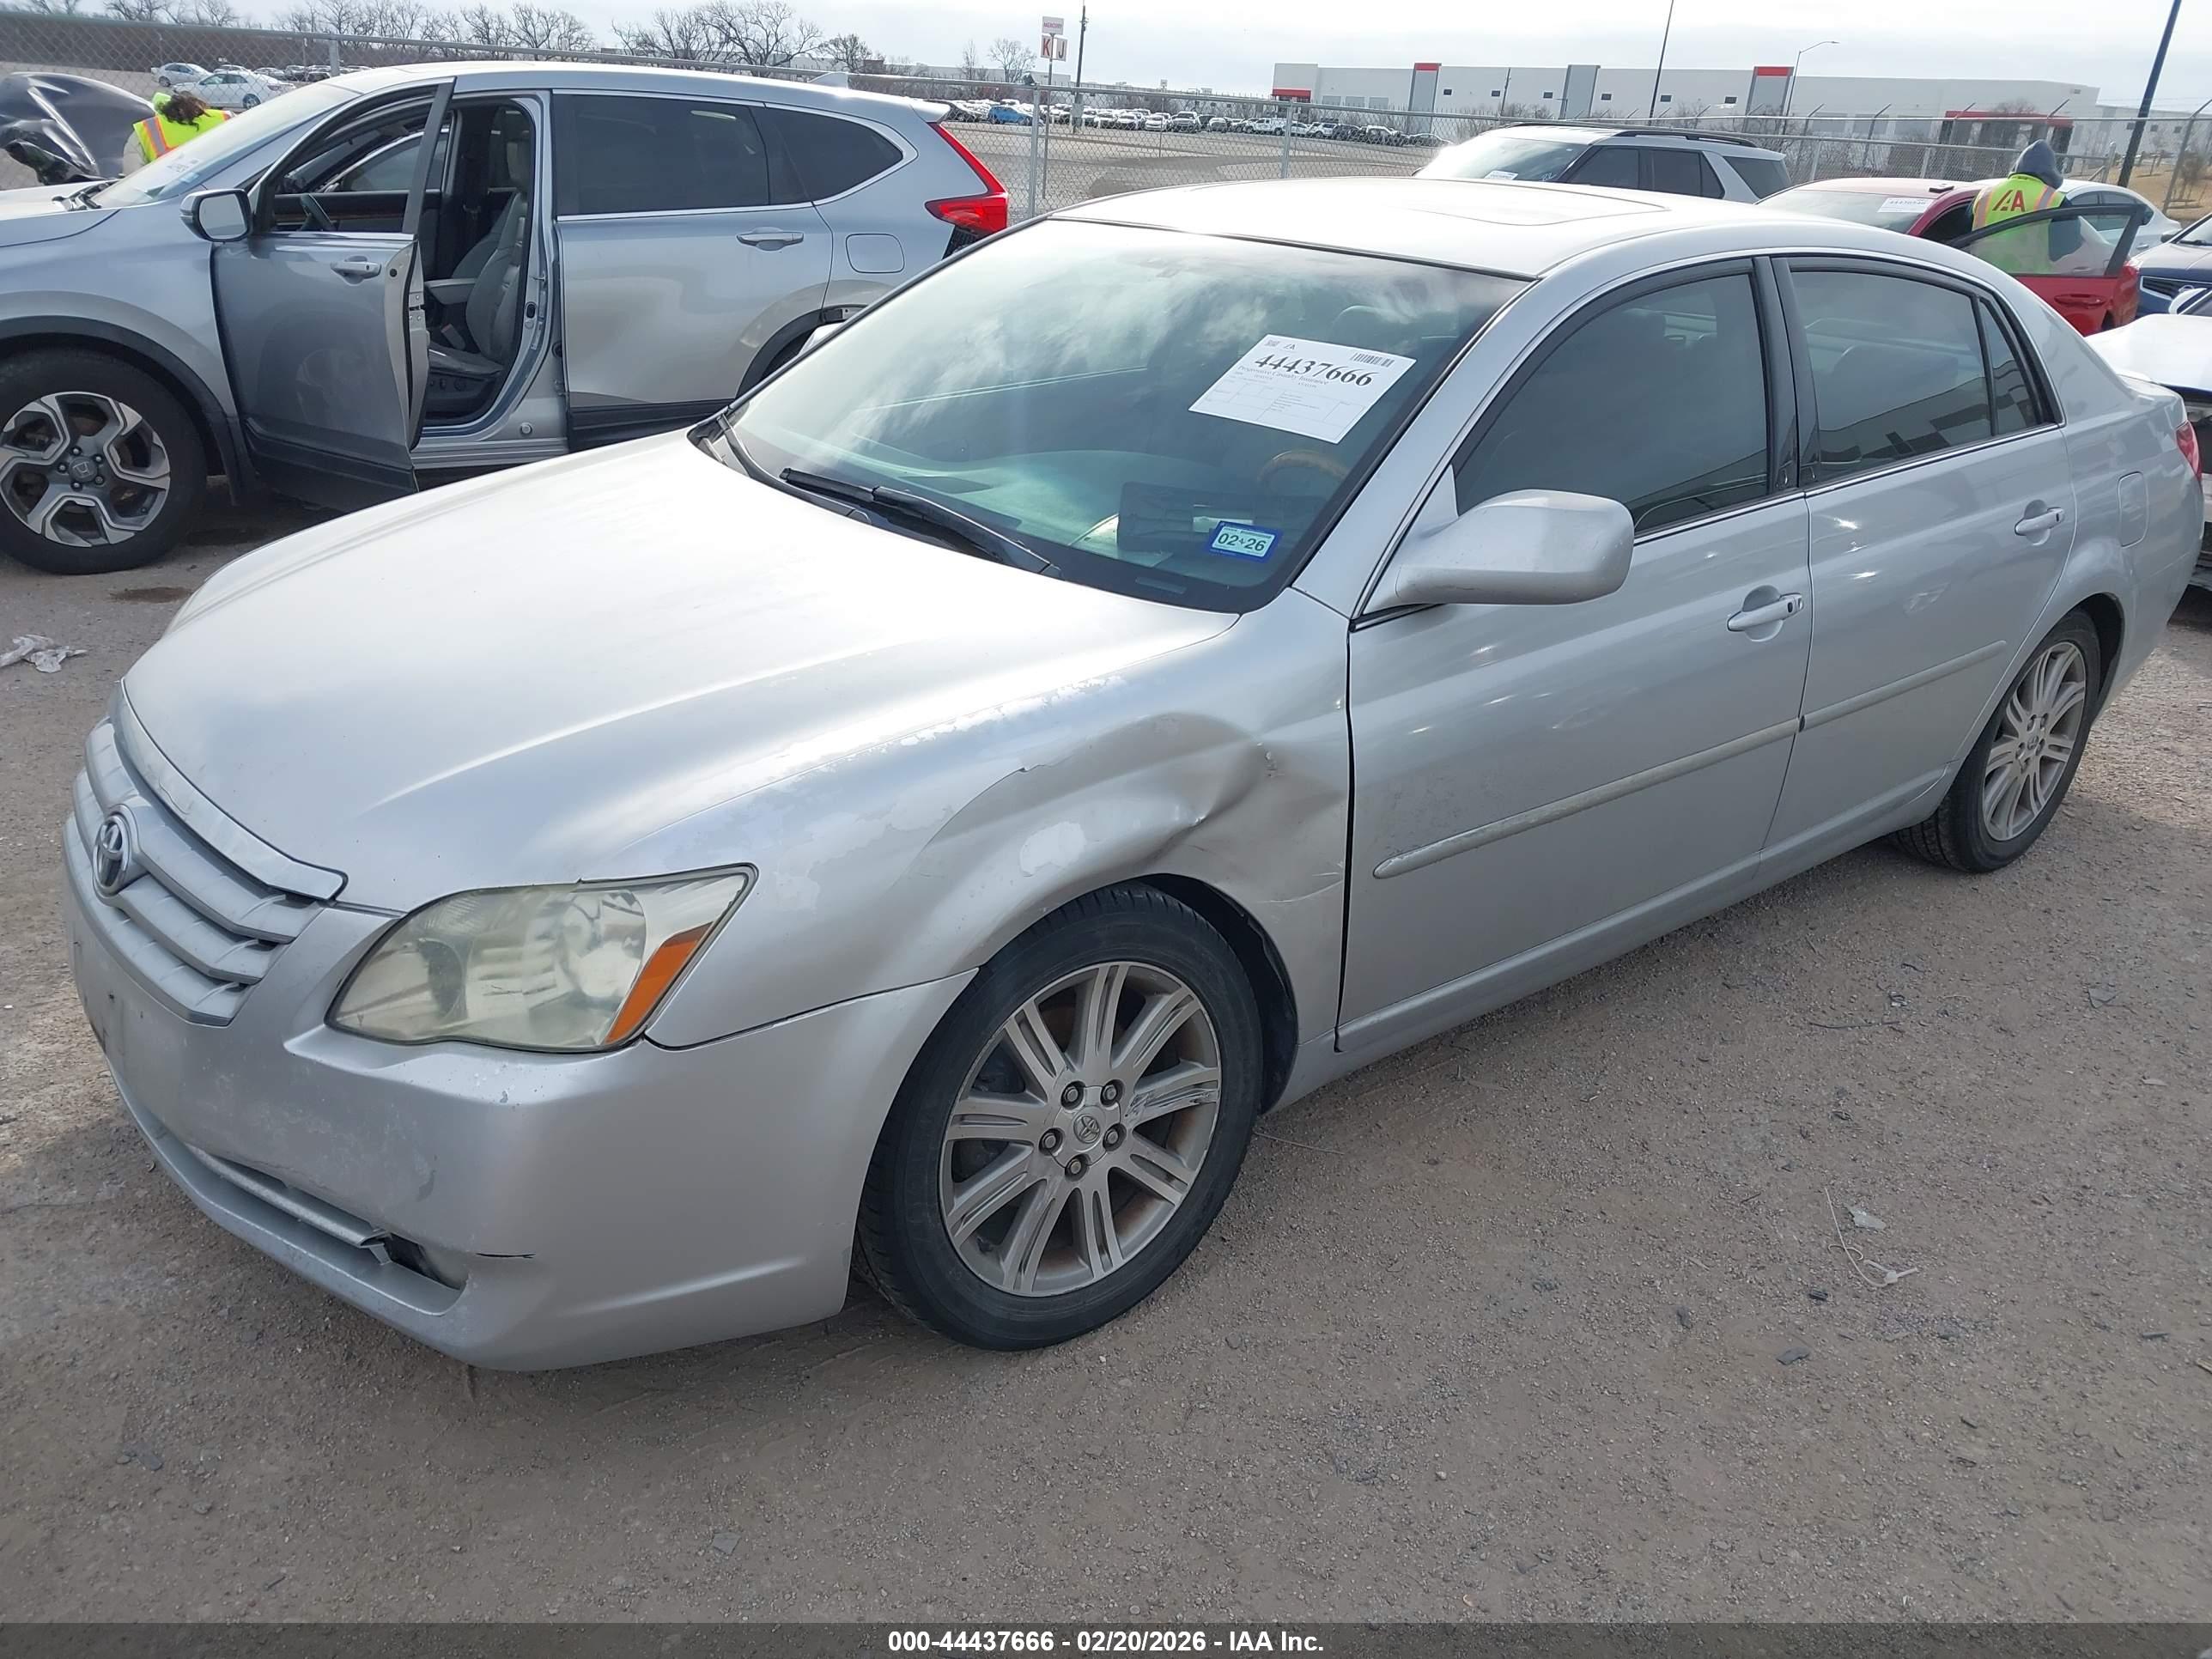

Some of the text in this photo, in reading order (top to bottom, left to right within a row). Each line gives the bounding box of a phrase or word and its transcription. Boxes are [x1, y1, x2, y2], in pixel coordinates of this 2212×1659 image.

[1255, 354, 1380, 386] 44437666
[1218, 533, 1267, 551] 02 26
